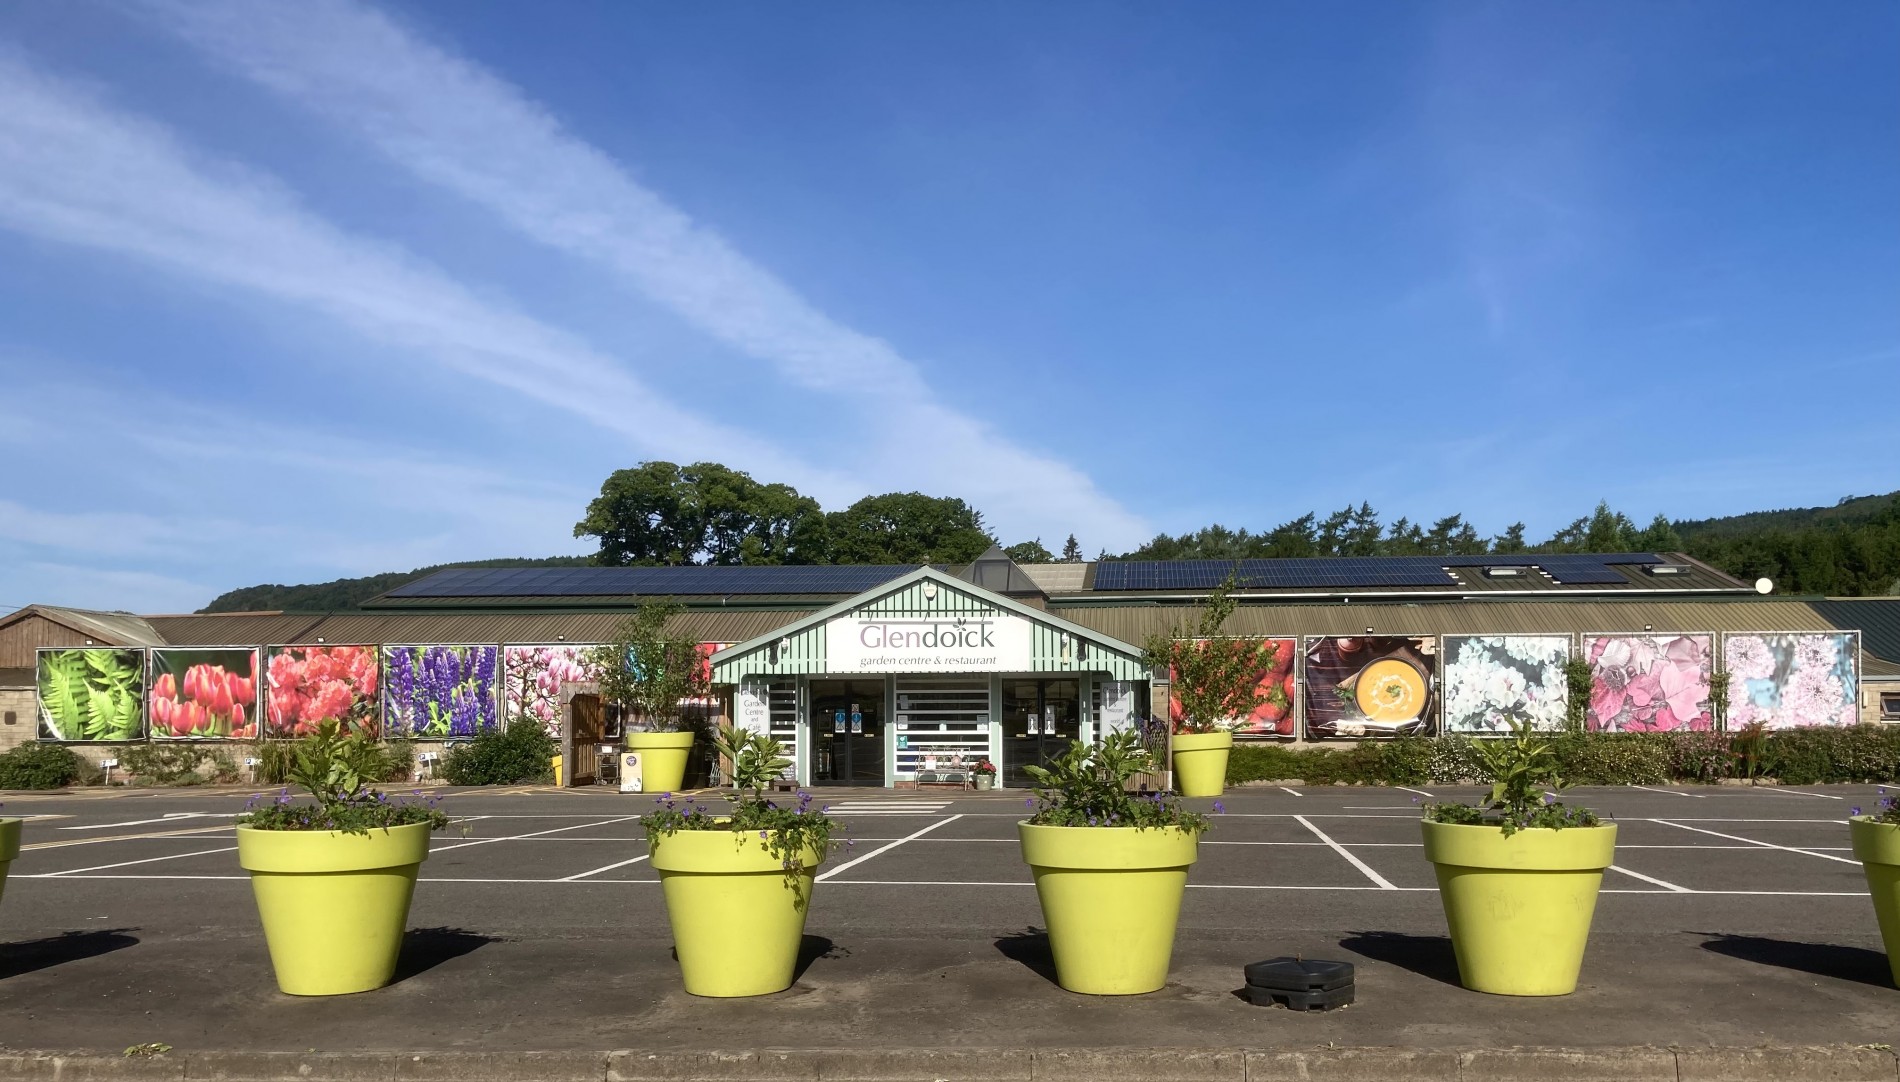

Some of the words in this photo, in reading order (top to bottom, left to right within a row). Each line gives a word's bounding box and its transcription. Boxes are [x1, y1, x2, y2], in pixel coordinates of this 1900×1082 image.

[860, 622, 995, 648] Glendoick
[860, 656, 896, 668] garden
[898, 656, 932, 665] centre
[933, 656, 942, 665] &
[944, 656, 997, 665] restaurant
